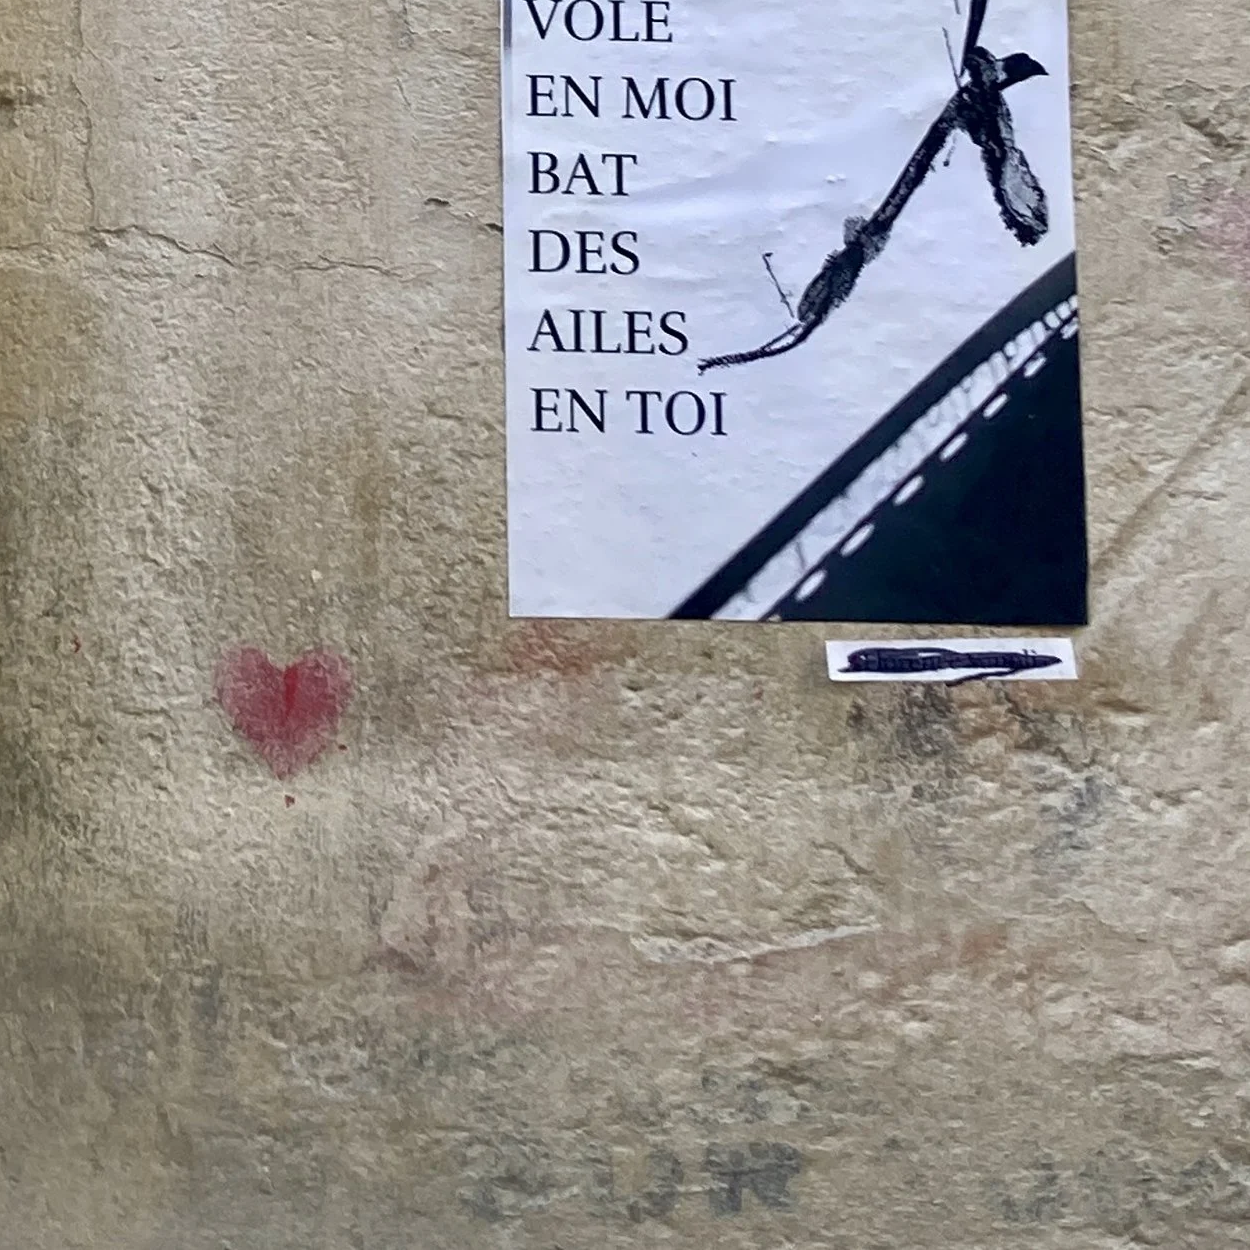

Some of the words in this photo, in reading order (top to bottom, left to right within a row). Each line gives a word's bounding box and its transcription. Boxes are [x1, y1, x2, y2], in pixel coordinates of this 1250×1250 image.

[526, 75, 602, 117] EN
[622, 77, 736, 121] MOI
[528, 152, 637, 196] BAT
[529, 230, 639, 275] DES
[527, 309, 688, 355] AILES
[531, 388, 607, 433] EN
[626, 391, 727, 435] TOI
